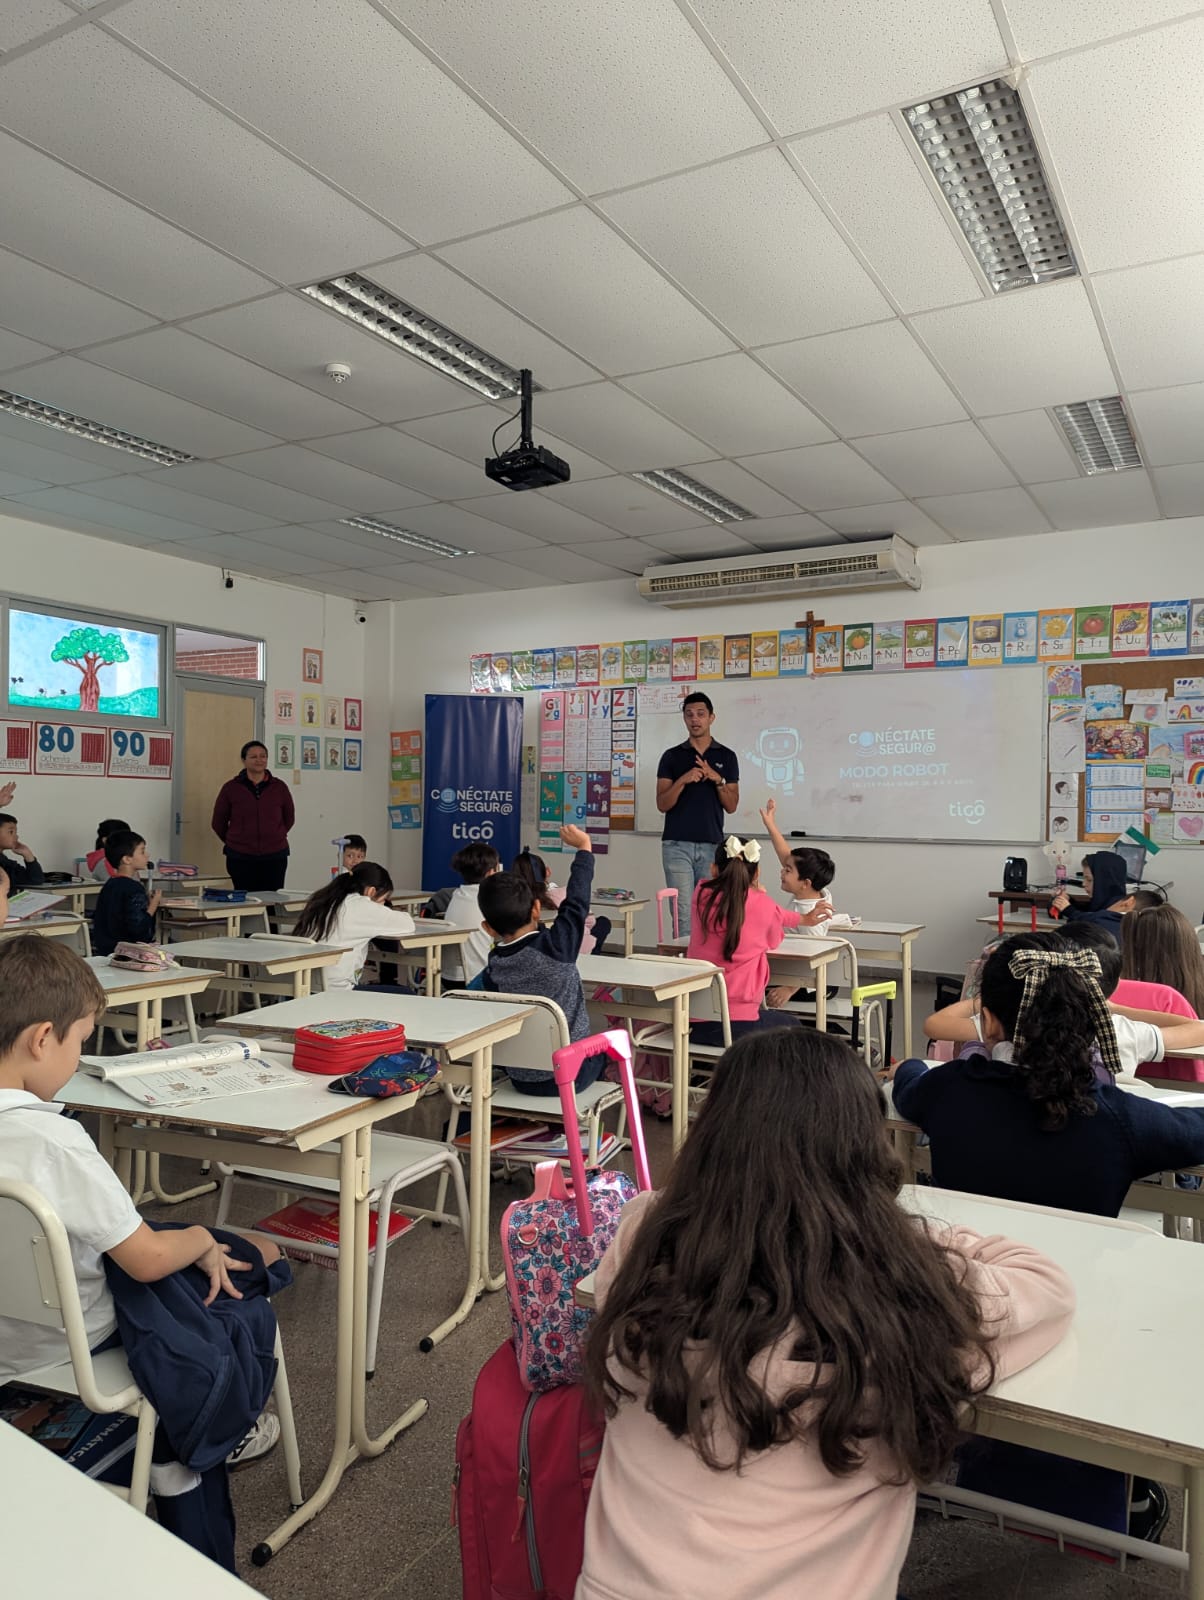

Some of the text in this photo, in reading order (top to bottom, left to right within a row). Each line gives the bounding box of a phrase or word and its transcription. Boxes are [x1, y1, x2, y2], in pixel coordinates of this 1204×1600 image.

[1052, 639, 1064, 650] Ss
[1125, 635, 1141, 645] Uu
[1163, 632, 1178, 643] Vv
[545, 698, 554, 710] G
[569, 692, 576, 705] J
[590, 689, 600, 706] Y
[613, 690, 625, 707] Z
[553, 709, 560, 720] g
[602, 705, 610, 719] y
[626, 706, 635, 717] z
[38, 724, 75, 753] 80
[848, 726, 936, 746] CONÉCTATE
[112, 730, 146, 757] 90
[879, 742, 937, 756] SEGUR@
[567, 771, 583, 785] Ge
[839, 762, 951, 780] MODO ROBOT
[430, 785, 513, 803] CONÉCTATE
[459, 801, 513, 816] SEGUR@
[948, 799, 986, 818] tigo
[452, 820, 494, 840] tigo
